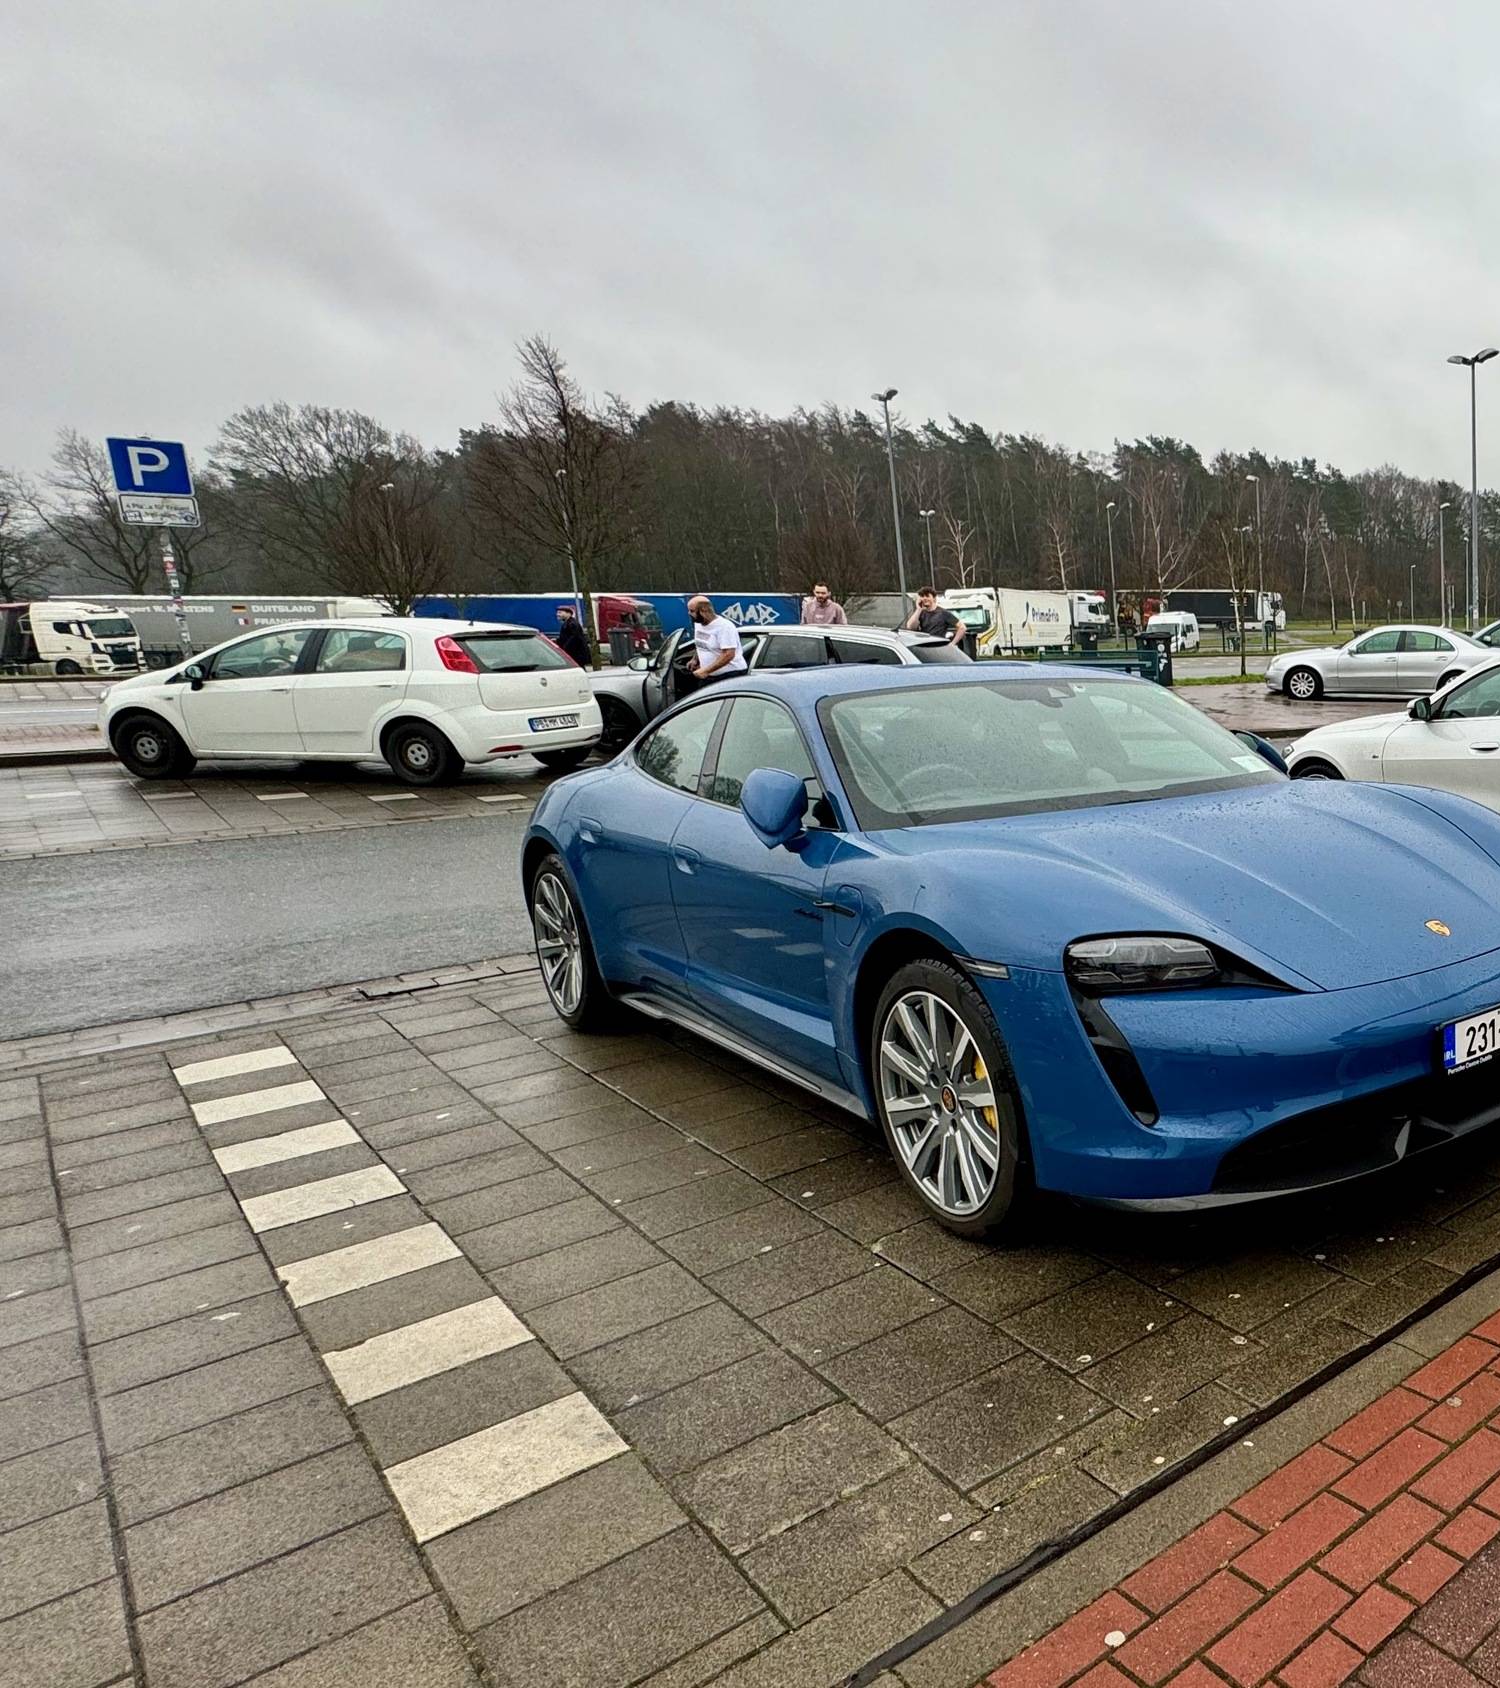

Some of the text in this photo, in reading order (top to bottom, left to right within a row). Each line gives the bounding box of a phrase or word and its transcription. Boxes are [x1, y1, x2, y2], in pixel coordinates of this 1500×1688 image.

[127, 446, 169, 487] P
[251, 605, 316, 613] DUITSLAND
[1444, 1049, 1456, 1061] IRL
